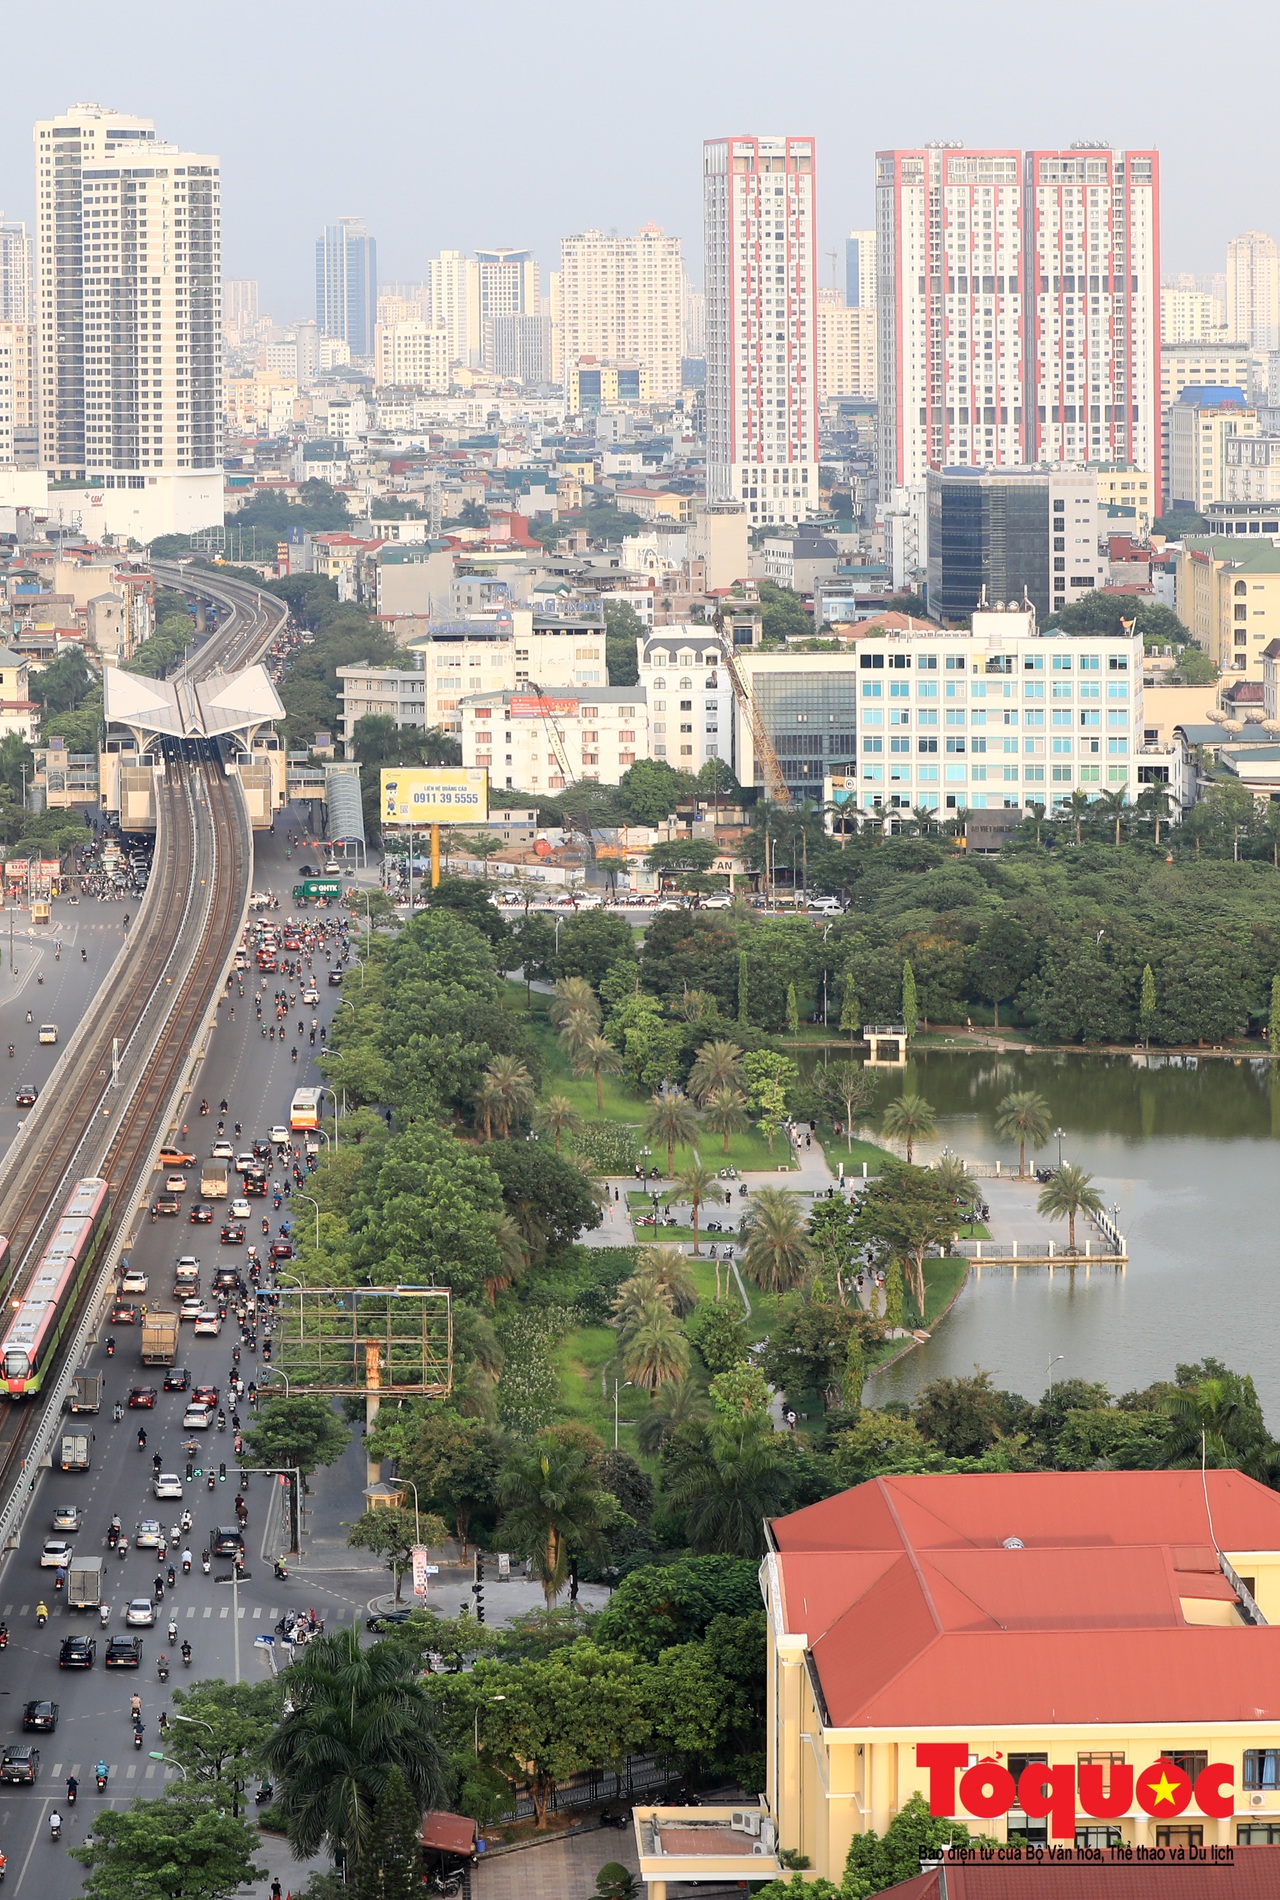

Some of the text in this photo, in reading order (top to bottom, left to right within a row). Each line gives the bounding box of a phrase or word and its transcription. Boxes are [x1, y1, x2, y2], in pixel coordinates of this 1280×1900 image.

[414, 793, 478, 804] 0911 39 5555
